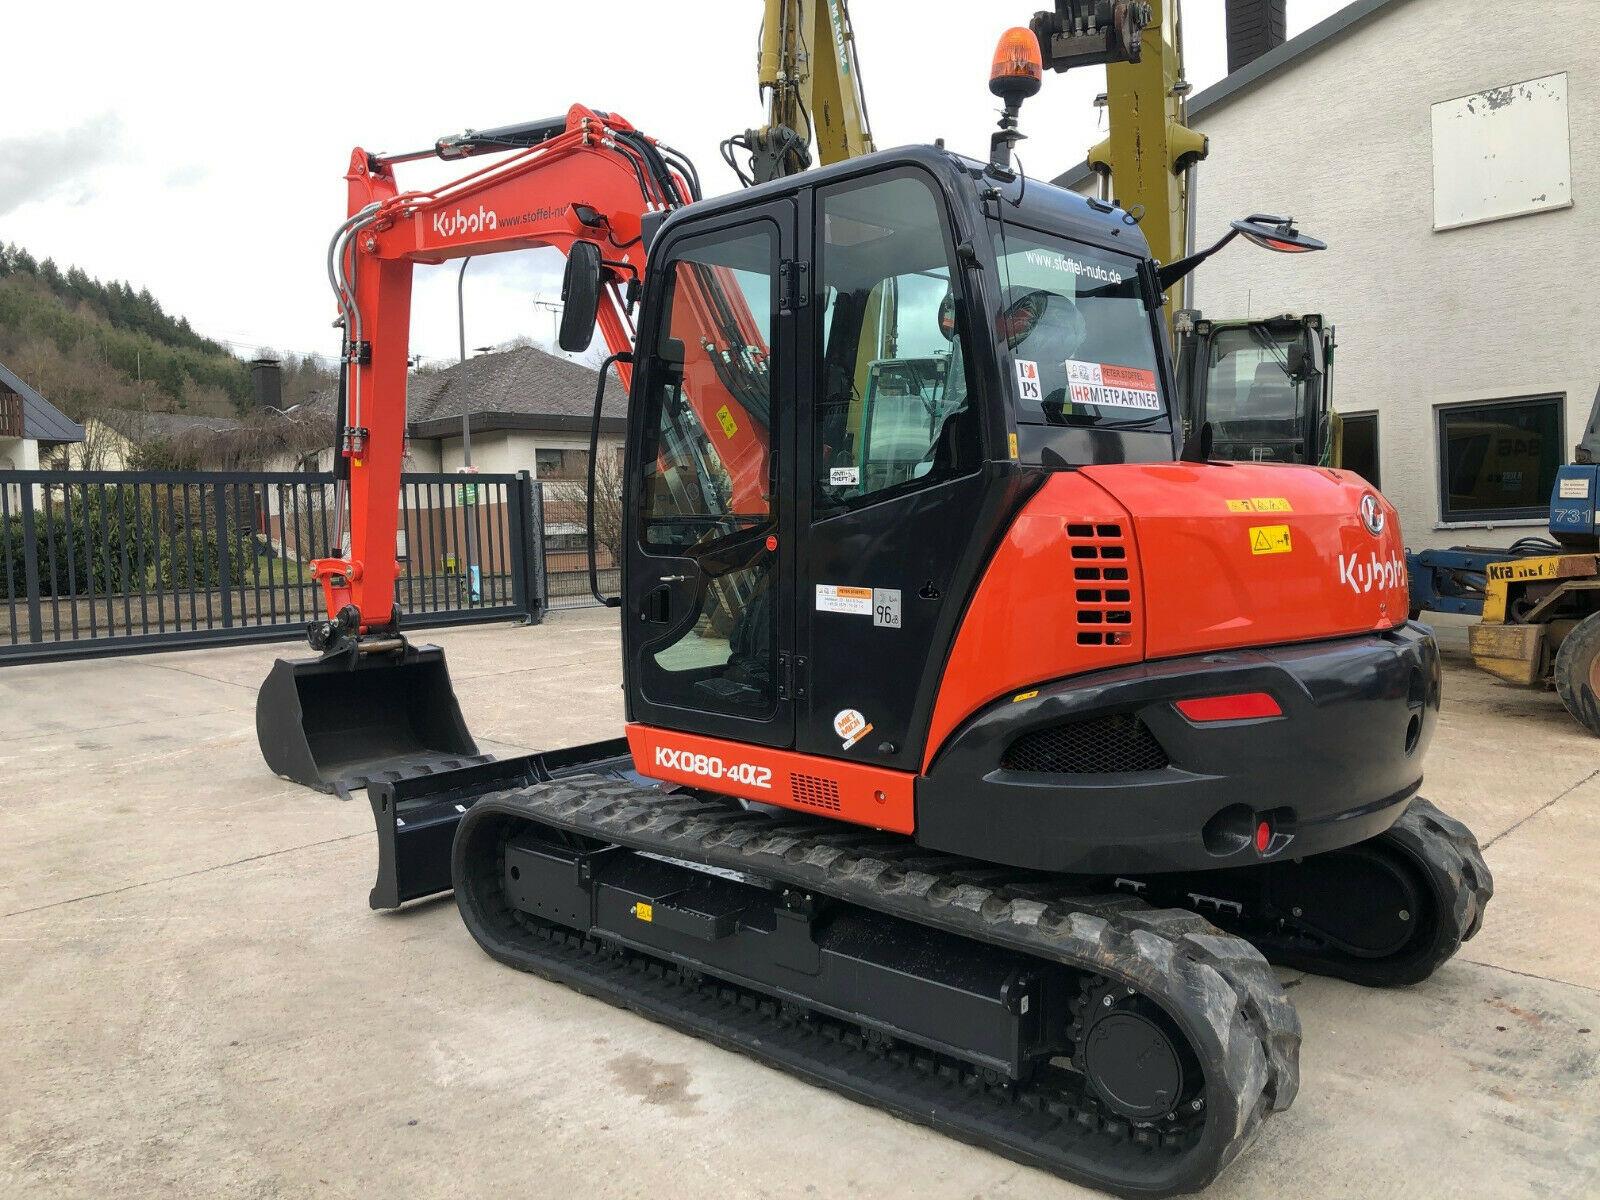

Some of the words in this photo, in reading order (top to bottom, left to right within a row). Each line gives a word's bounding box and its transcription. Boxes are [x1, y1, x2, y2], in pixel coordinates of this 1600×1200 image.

[433, 205, 497, 237] Kubota
[1025, 251, 1122, 284] www.stoffel-nuta.de
[1022, 382, 1039, 398] PS
[1554, 508, 1591, 525] 731
[1339, 550, 1405, 593] Kubota
[876, 605, 892, 624] 96
[838, 711, 856, 729] MIET
[841, 720, 860, 736] MICH
